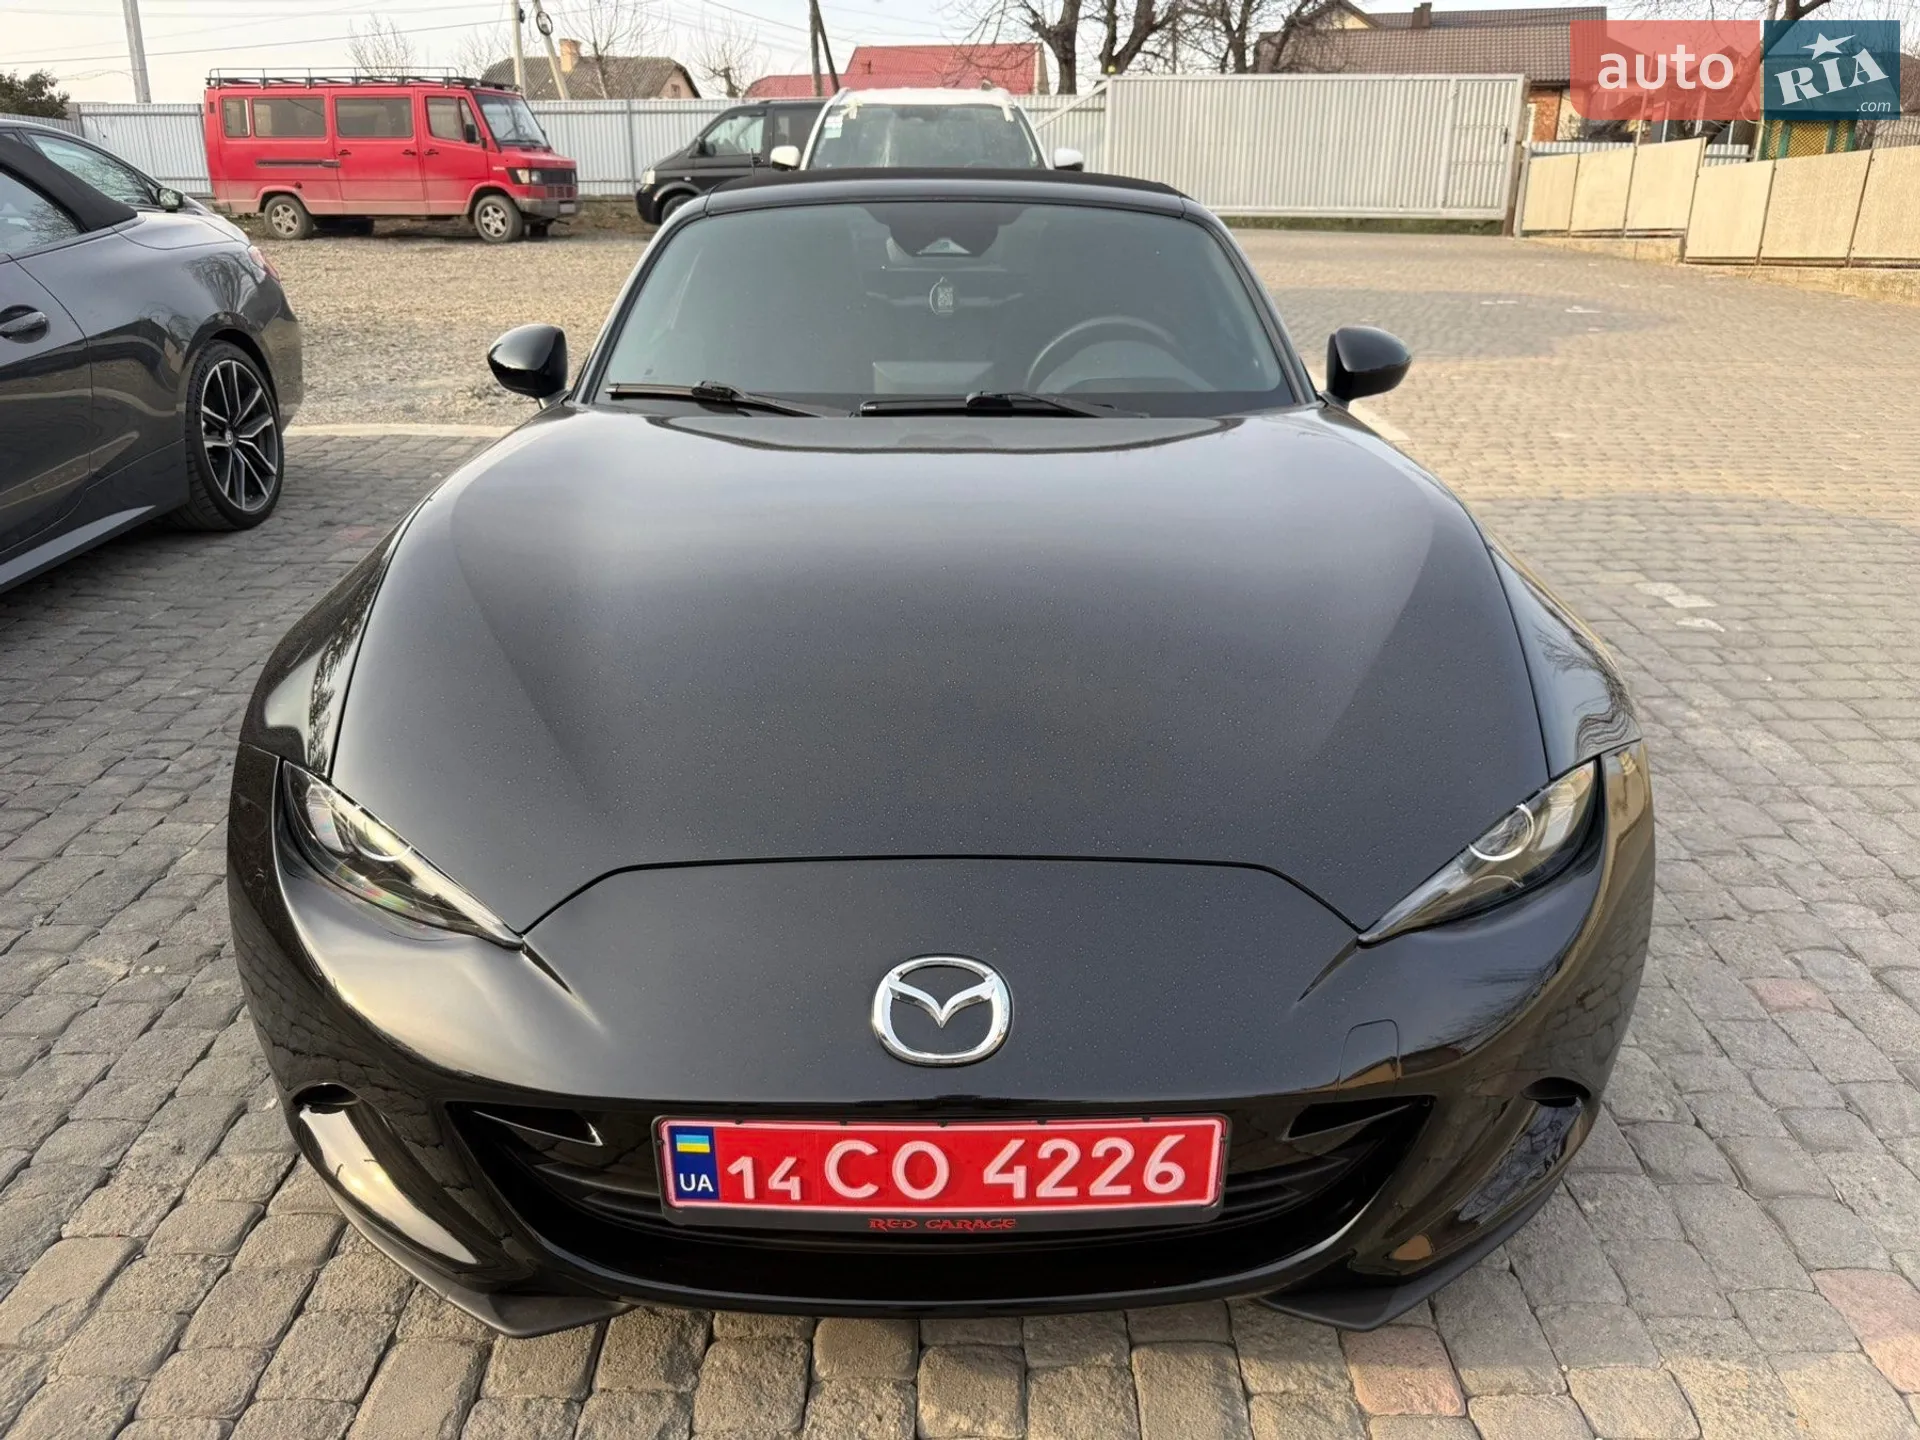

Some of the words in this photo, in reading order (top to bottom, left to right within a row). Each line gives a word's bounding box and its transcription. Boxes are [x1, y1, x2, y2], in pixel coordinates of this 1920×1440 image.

[727, 1156, 801, 1200] 14
[824, 1139, 950, 1200] CO
[983, 1134, 1187, 1199] 4226
[679, 1173, 713, 1193] UA
[868, 1218, 918, 1231] RED
[924, 1218, 1018, 1231] GARAGE
